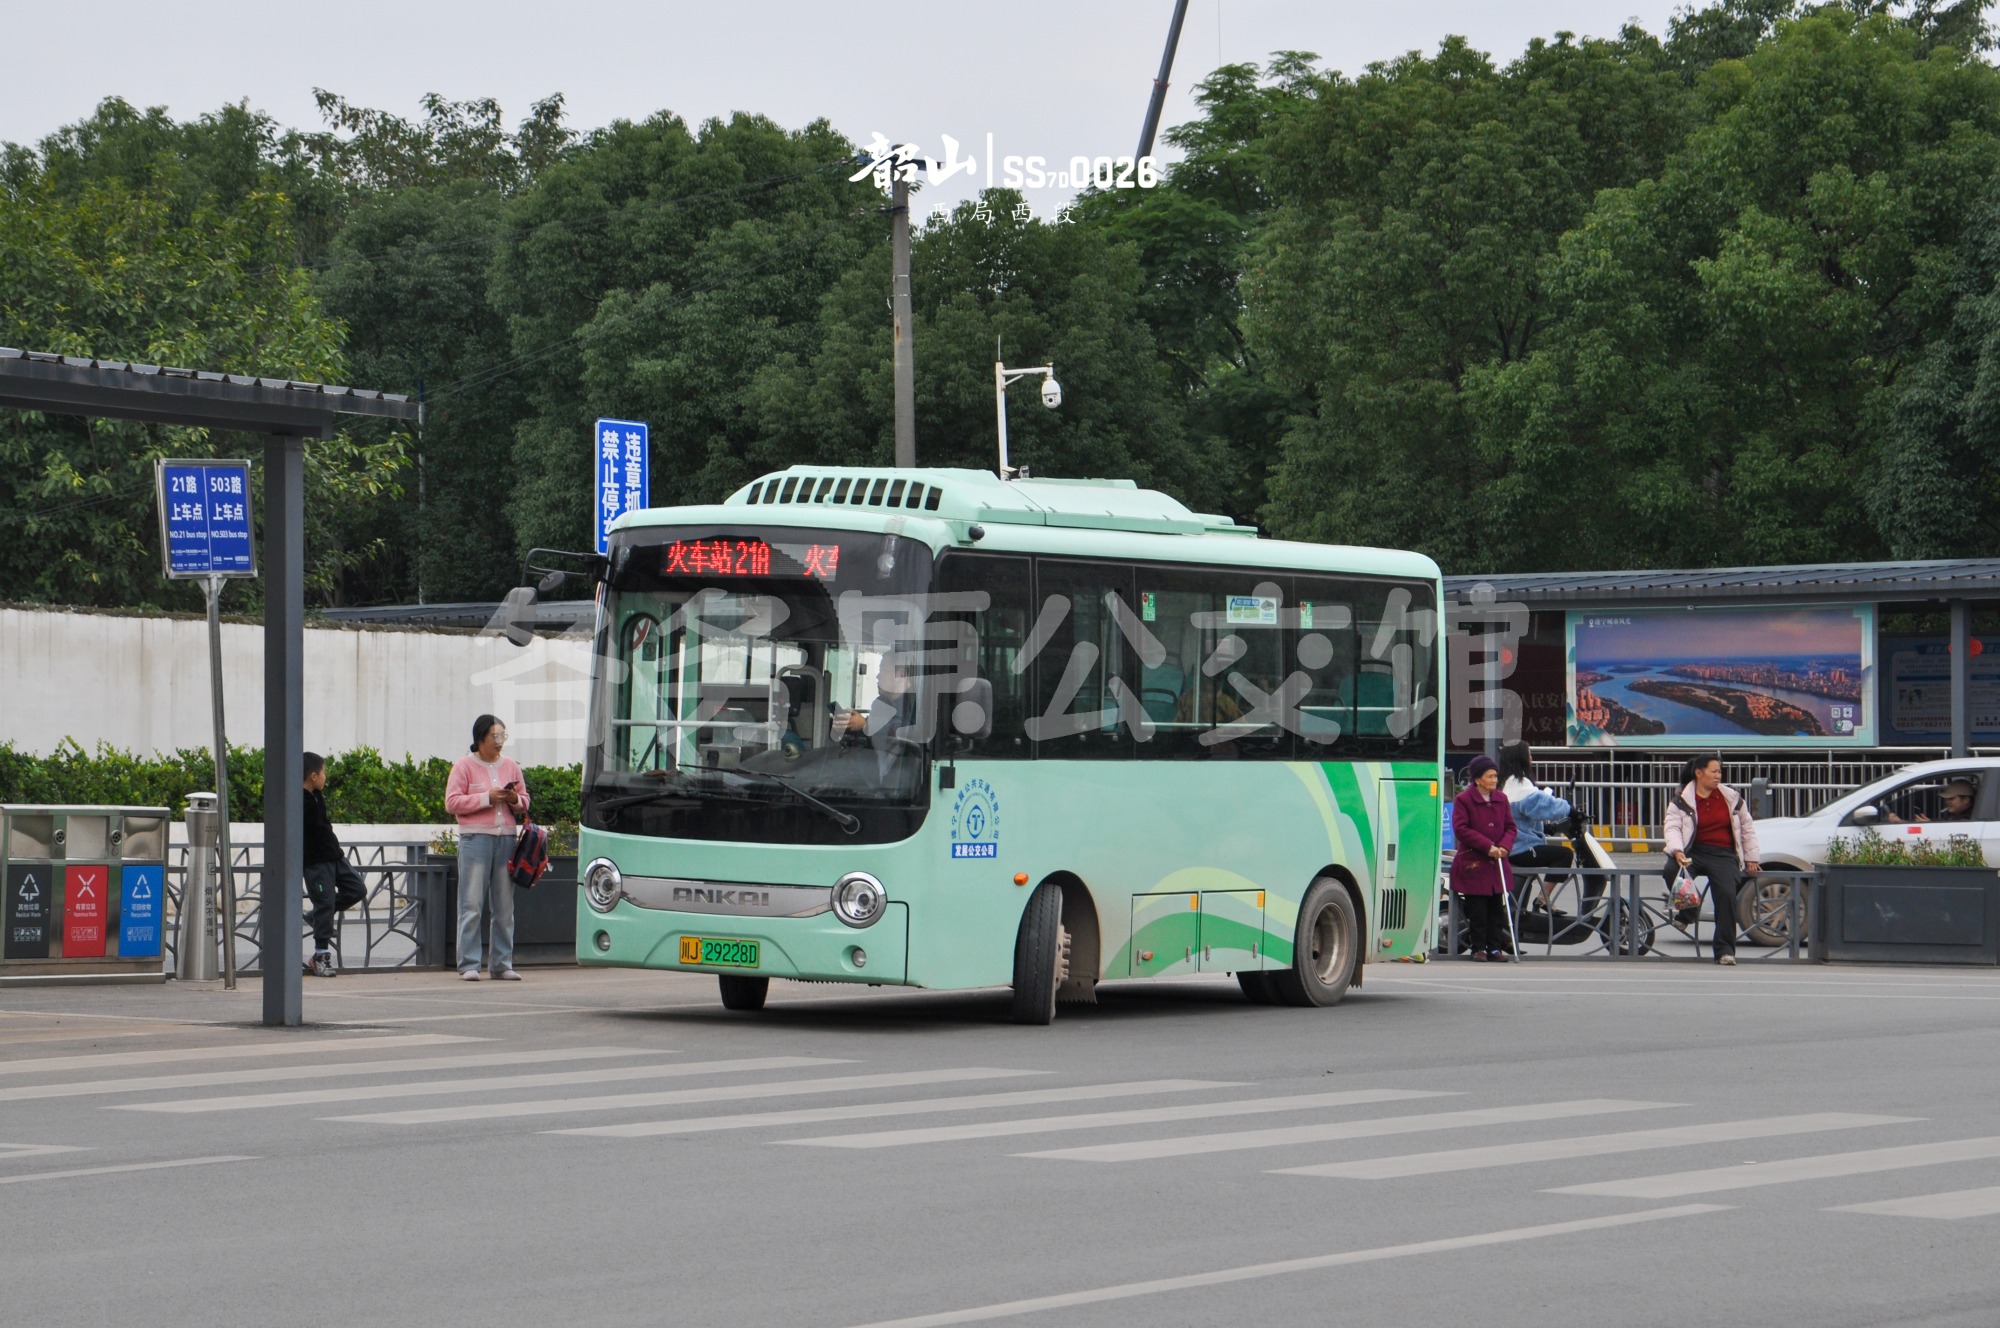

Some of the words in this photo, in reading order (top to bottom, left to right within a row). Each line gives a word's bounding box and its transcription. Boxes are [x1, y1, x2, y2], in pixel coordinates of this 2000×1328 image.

[171, 475, 197, 494] 21路
[210, 476, 242, 494] 503路
[171, 502, 204, 521] 上车点
[212, 502, 244, 521] 上车点
[170, 530, 185, 538] NO.21
[186, 530, 195, 538] bus
[196, 531, 207, 540] stop
[211, 530, 228, 538] NO.503
[229, 530, 237, 538] bus
[238, 531, 248, 540] stop
[955, 844, 994, 857] 发展公交公司
[673, 887, 769, 906] ANKAI
[204, 886, 214, 937] 烟头不落地
